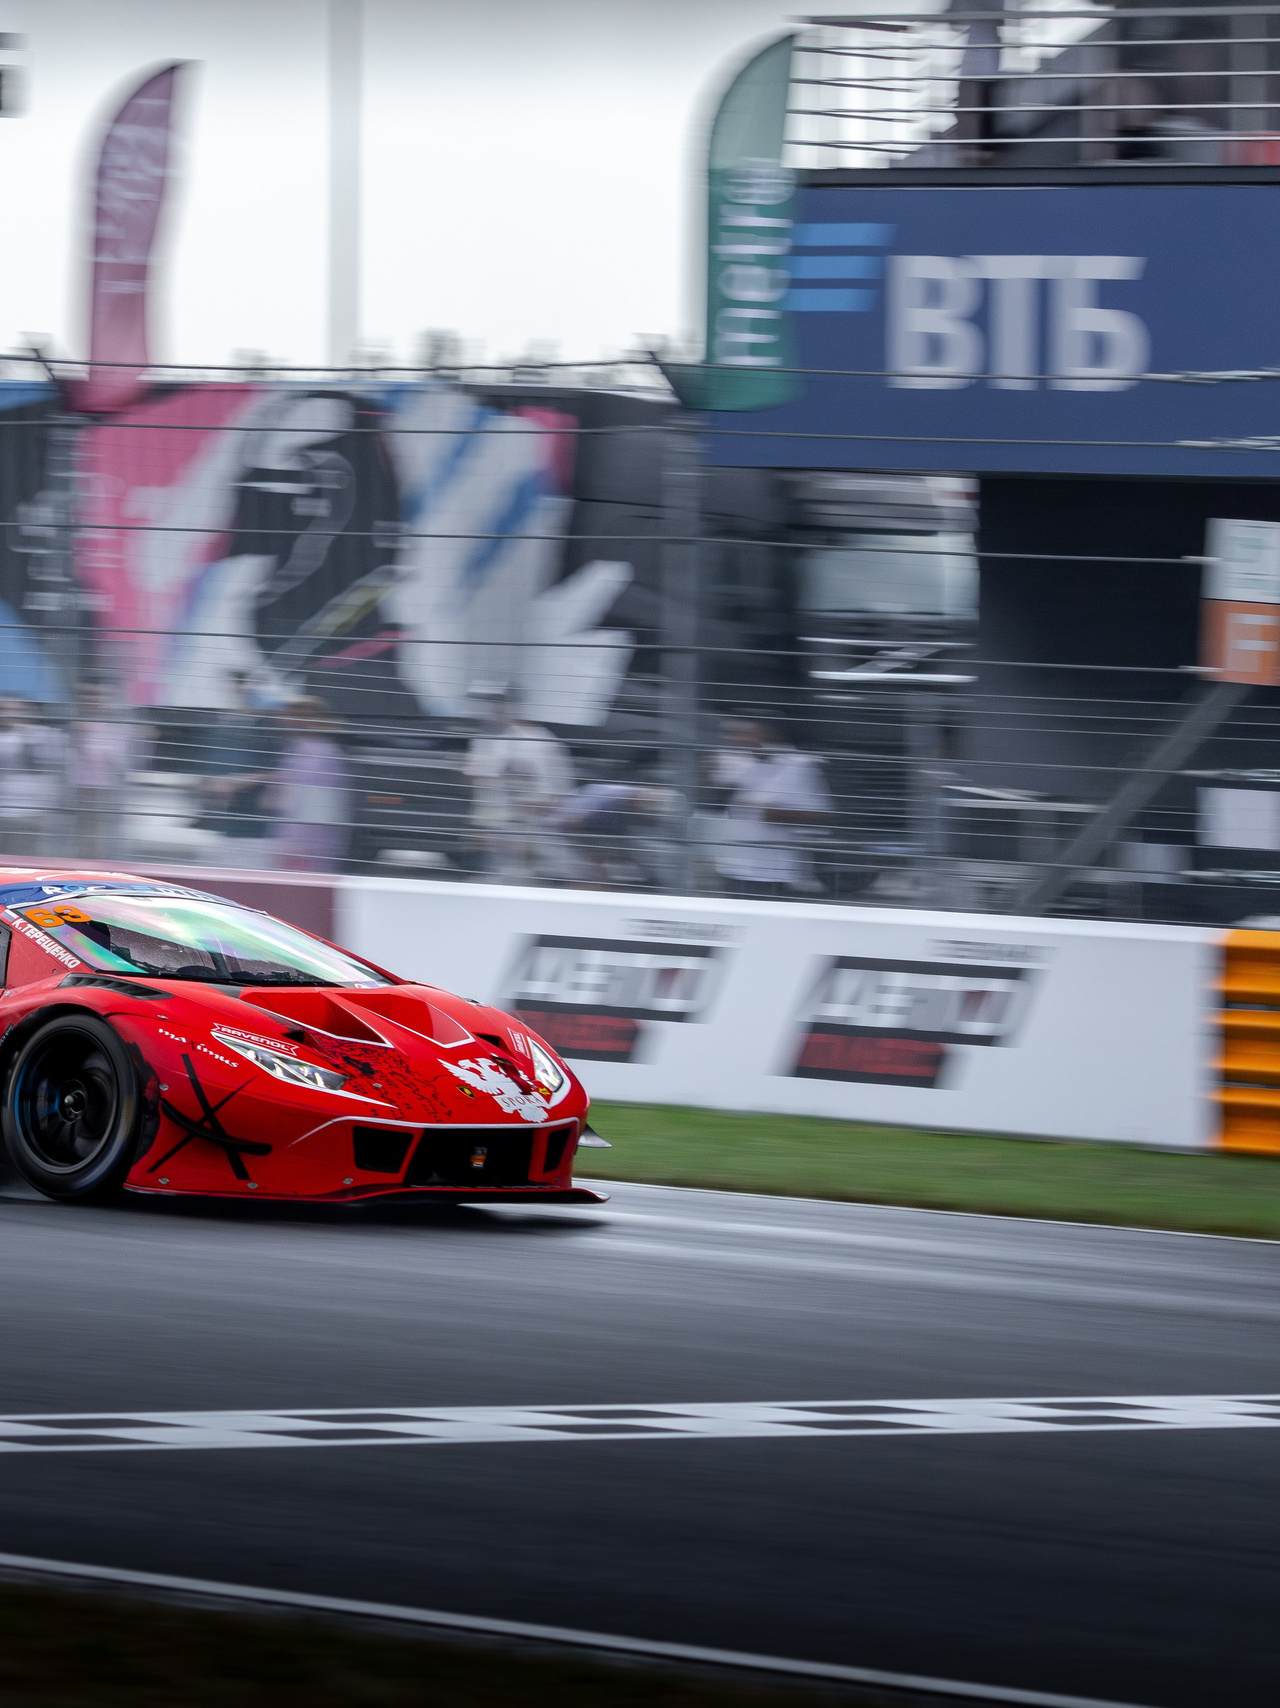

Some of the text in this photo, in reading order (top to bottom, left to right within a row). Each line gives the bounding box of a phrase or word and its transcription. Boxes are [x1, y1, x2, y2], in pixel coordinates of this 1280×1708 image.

[884, 254, 1152, 391] ВТБ
[24, 905, 92, 928] 63
[221, 1027, 290, 1051] RAVENOL
